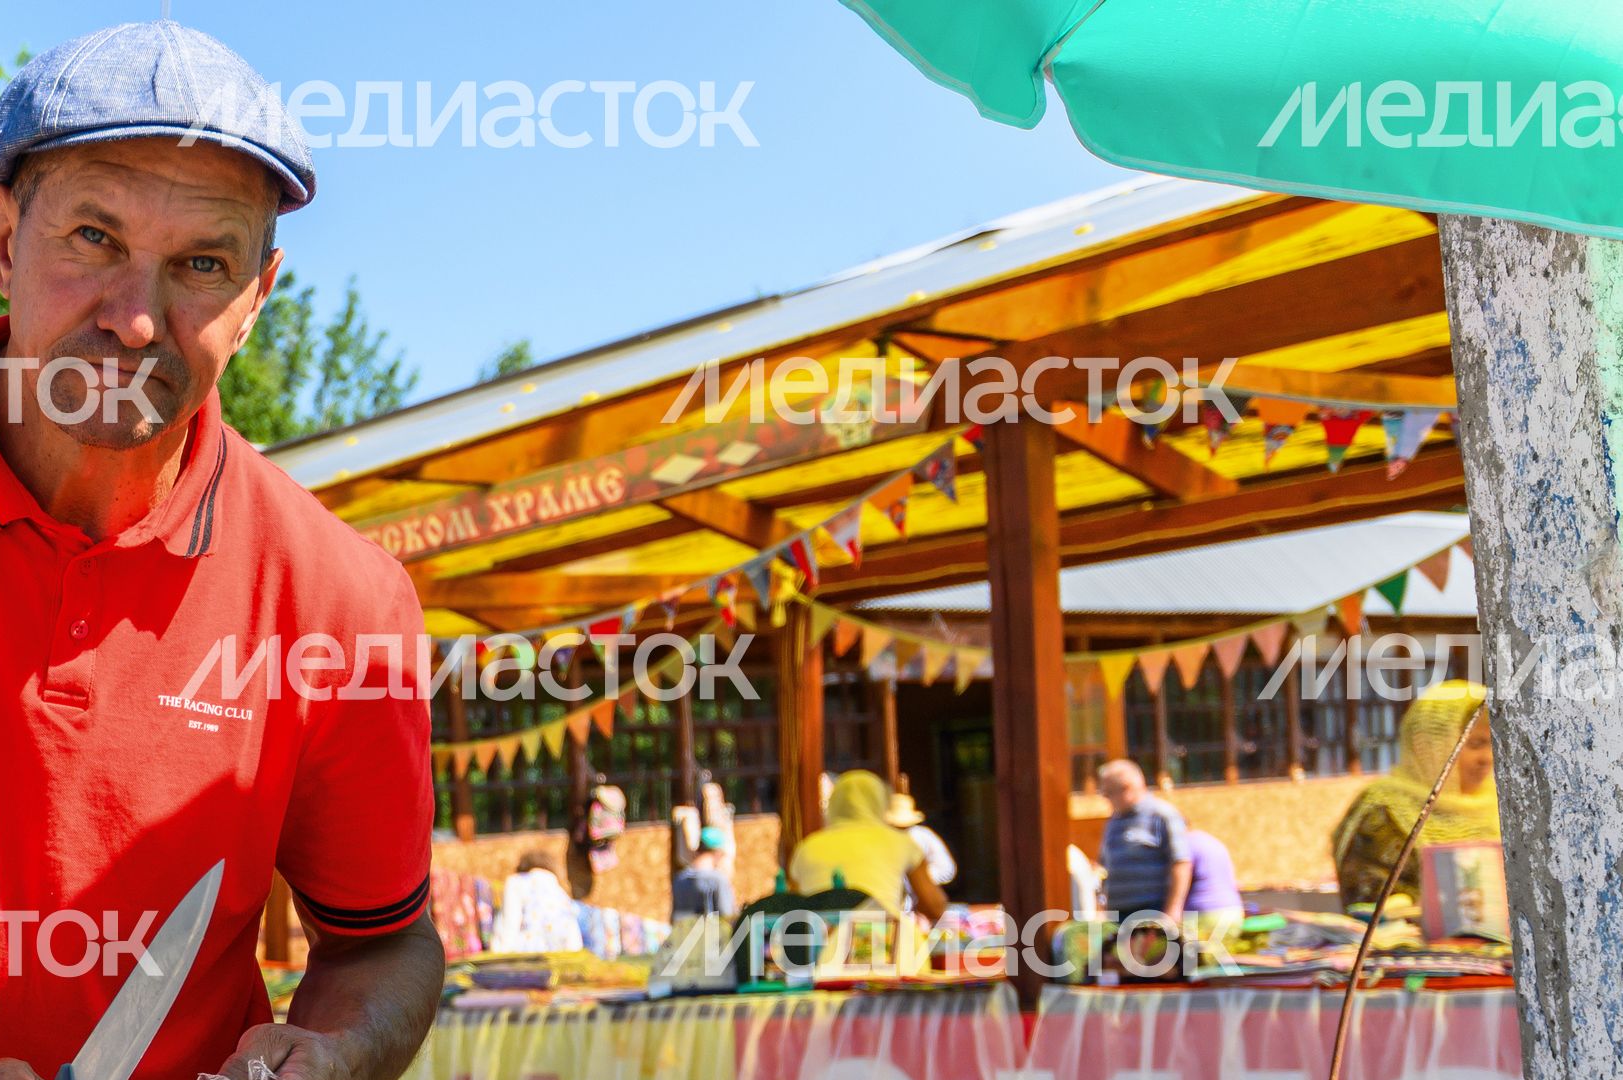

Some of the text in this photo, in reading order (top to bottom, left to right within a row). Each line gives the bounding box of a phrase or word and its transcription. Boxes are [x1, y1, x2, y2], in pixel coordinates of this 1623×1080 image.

[364, 507, 479, 558] СКОМ
[158, 695, 182, 708] THE
[184, 699, 223, 716] RACING
